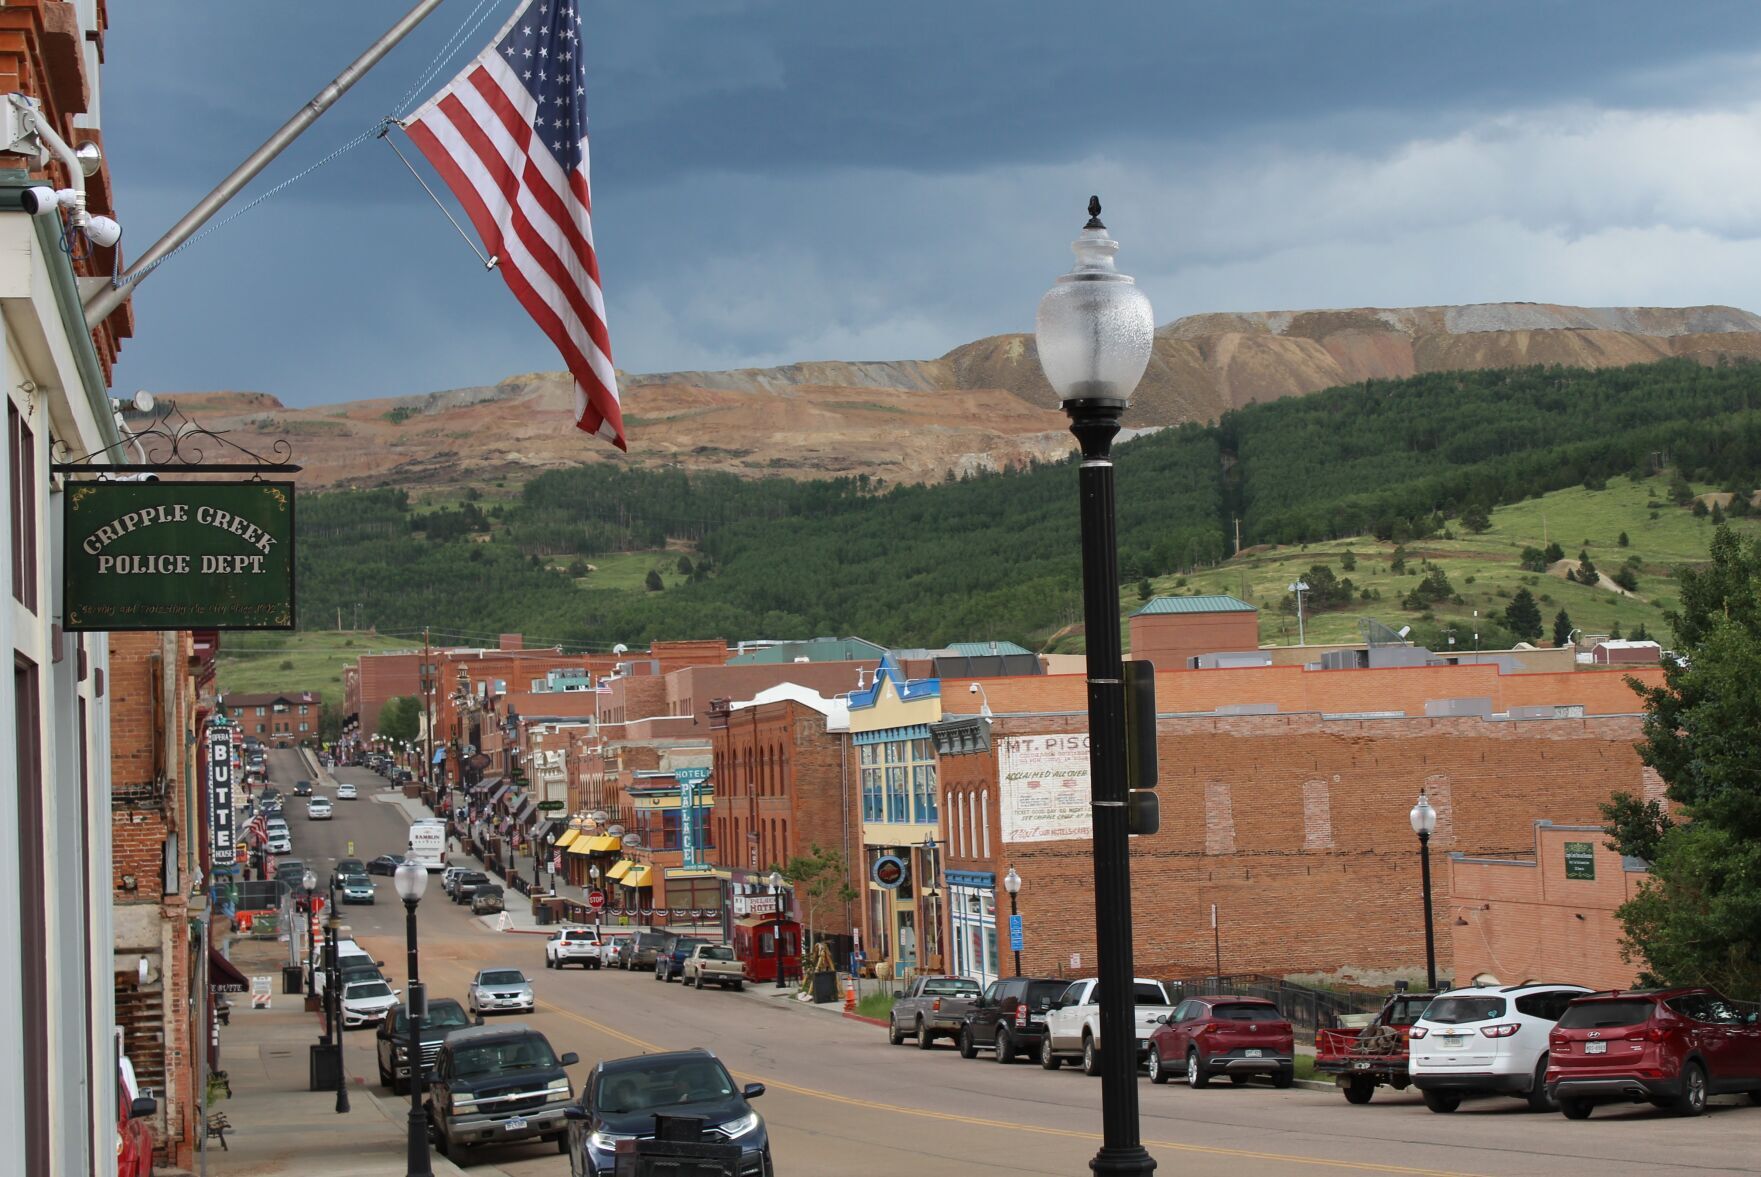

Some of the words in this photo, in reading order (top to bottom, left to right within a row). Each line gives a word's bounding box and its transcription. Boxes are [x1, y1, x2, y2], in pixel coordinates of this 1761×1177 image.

[83, 504, 189, 555] CRIPPLE
[196, 505, 278, 554] CREEK
[98, 555, 190, 574] POLICE
[201, 555, 266, 574] DEPT.
[212, 733, 229, 742] OPERA
[676, 769, 706, 778] HOTEL
[1005, 770, 1051, 780] ACCLAIMED
[215, 745, 230, 847] BUTTE
[682, 784, 691, 860] PALACE
[215, 850, 233, 858] HOUSE
[750, 904, 776, 912] HOTE
